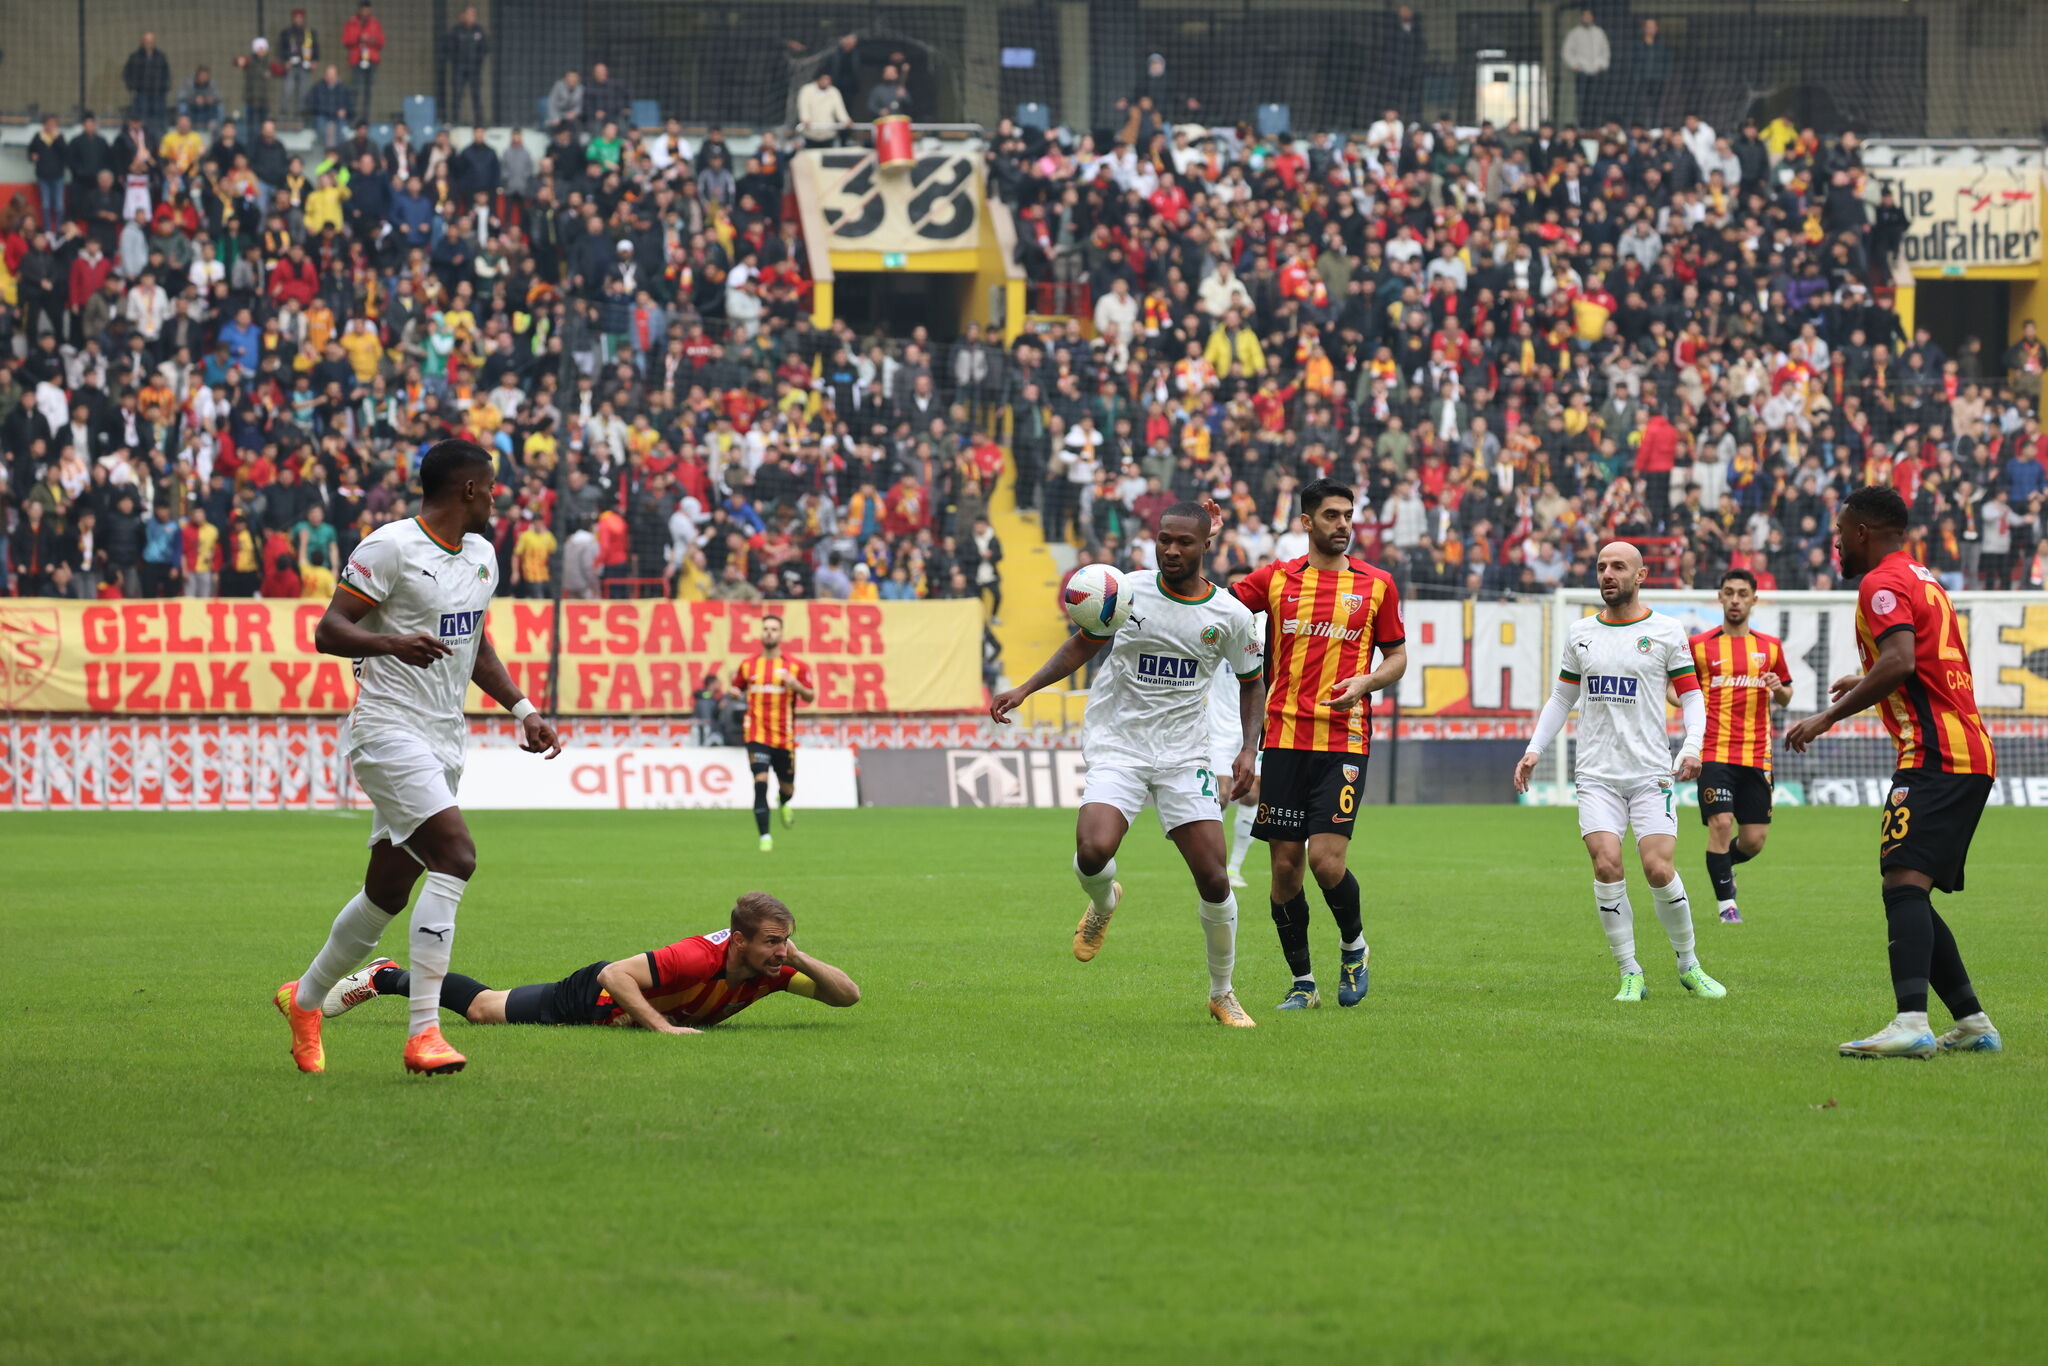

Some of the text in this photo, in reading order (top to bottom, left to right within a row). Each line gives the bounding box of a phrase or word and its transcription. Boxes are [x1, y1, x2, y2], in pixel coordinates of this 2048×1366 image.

[1300, 619, 1364, 641] istikbal
[1140, 655, 1196, 677] TAV
[84, 660, 253, 711] UZAK
[1589, 678, 1635, 695] TAV
[570, 752, 734, 808] afme
[1340, 785, 1355, 813] 6
[1661, 788, 1672, 812] 7
[1270, 807, 1305, 819] REGES
[1881, 807, 1911, 843] 23
